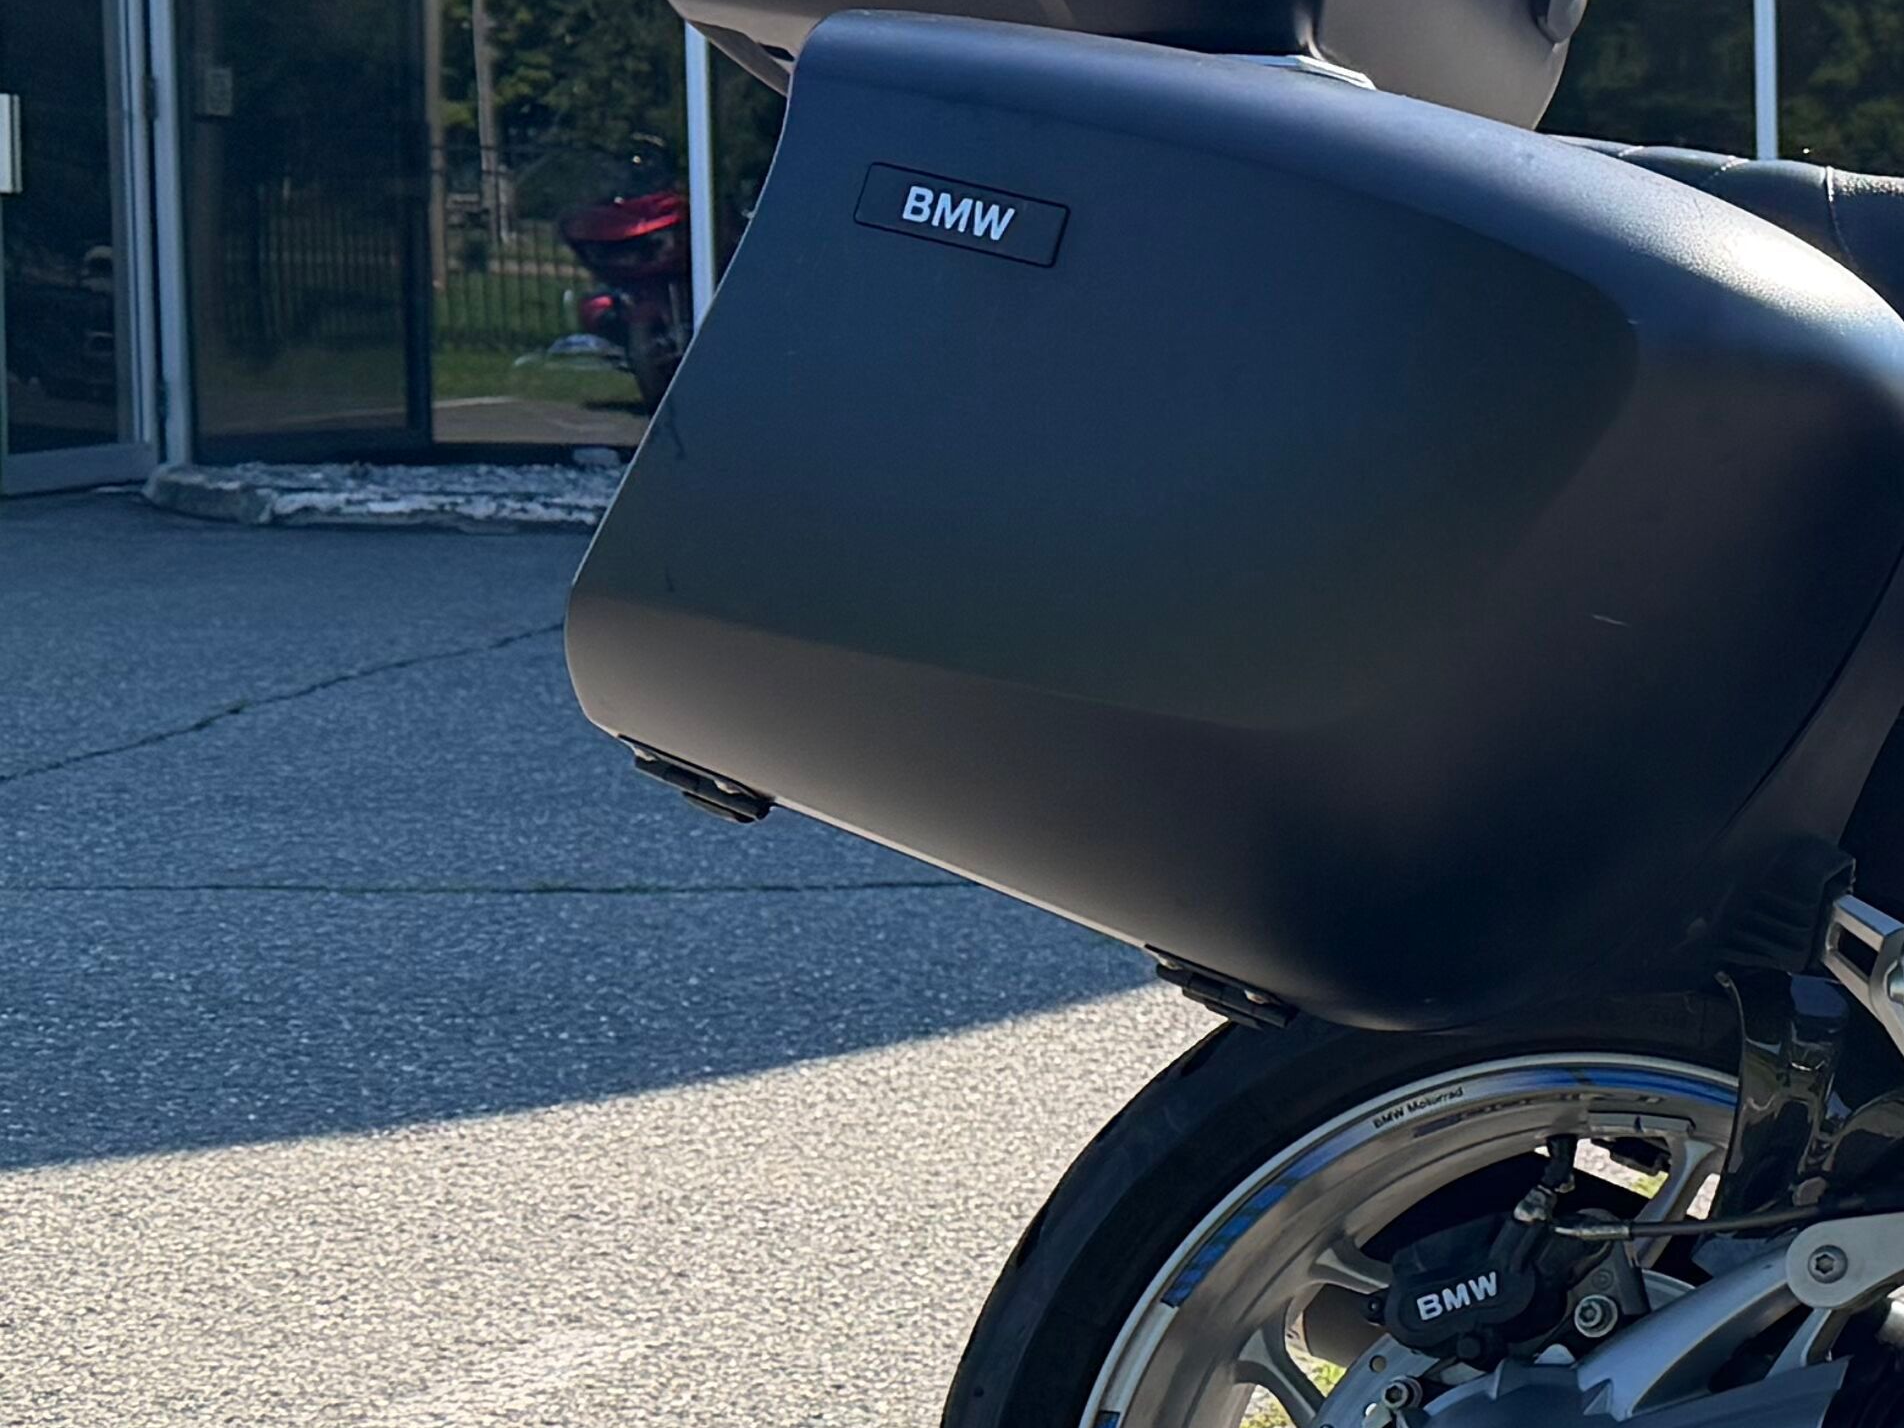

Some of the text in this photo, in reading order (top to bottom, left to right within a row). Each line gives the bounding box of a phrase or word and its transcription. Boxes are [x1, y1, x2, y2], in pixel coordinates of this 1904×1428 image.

[902, 185, 1015, 241] BMW
[1373, 1086, 1464, 1129] BMW Motorrad
[1416, 1271, 1498, 1321] BMW
